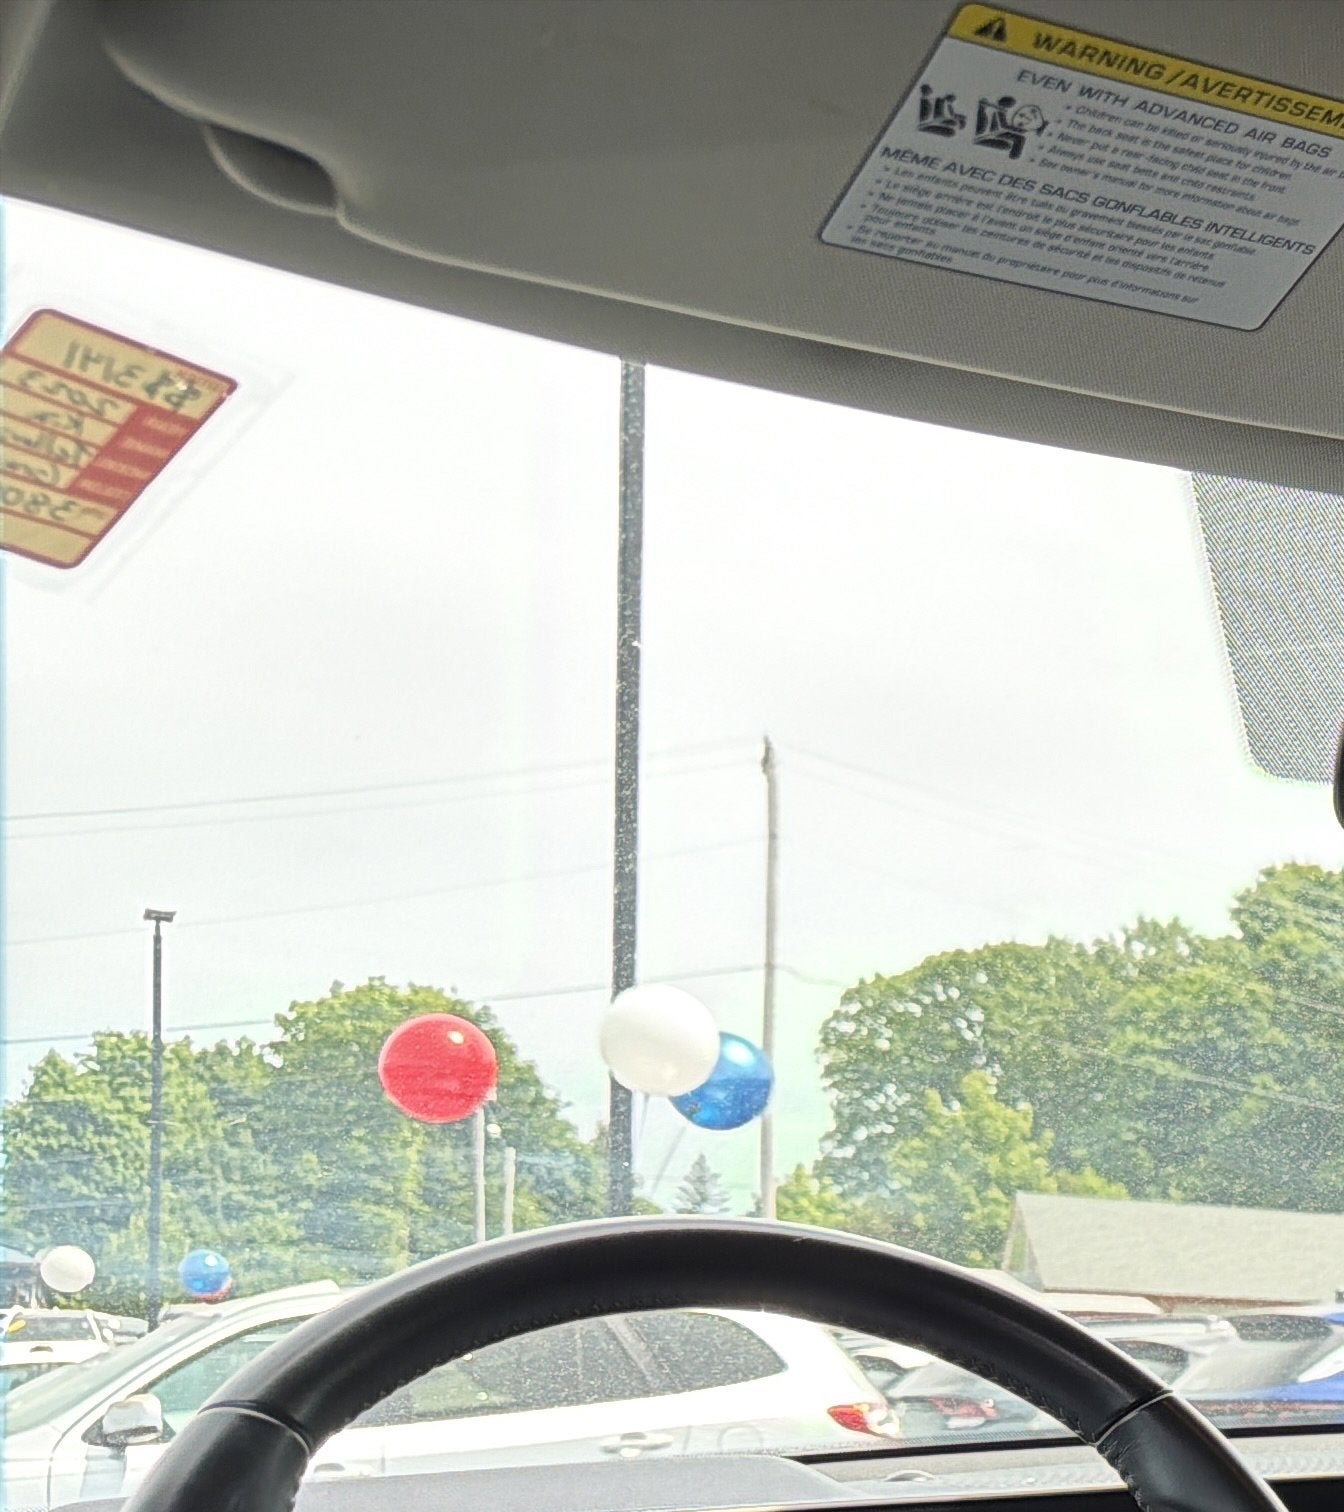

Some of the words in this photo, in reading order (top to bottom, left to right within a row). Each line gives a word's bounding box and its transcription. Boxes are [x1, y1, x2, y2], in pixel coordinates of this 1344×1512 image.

[1029, 31, 1169, 81] WARNING
[1016, 69, 1073, 93] EVEN
[1077, 84, 1130, 108] WITH
[1134, 99, 1241, 136] ADVANCED
[1243, 127, 1278, 145] AIR
[1280, 136, 1334, 159] BAGS
[943, 160, 998, 182] AVEC
[998, 173, 1039, 191] DES
[1039, 182, 1092, 203] SACS
[1092, 195, 1205, 229] GONFLABLES
[1204, 221, 1318, 255] INTELLIGENTS
